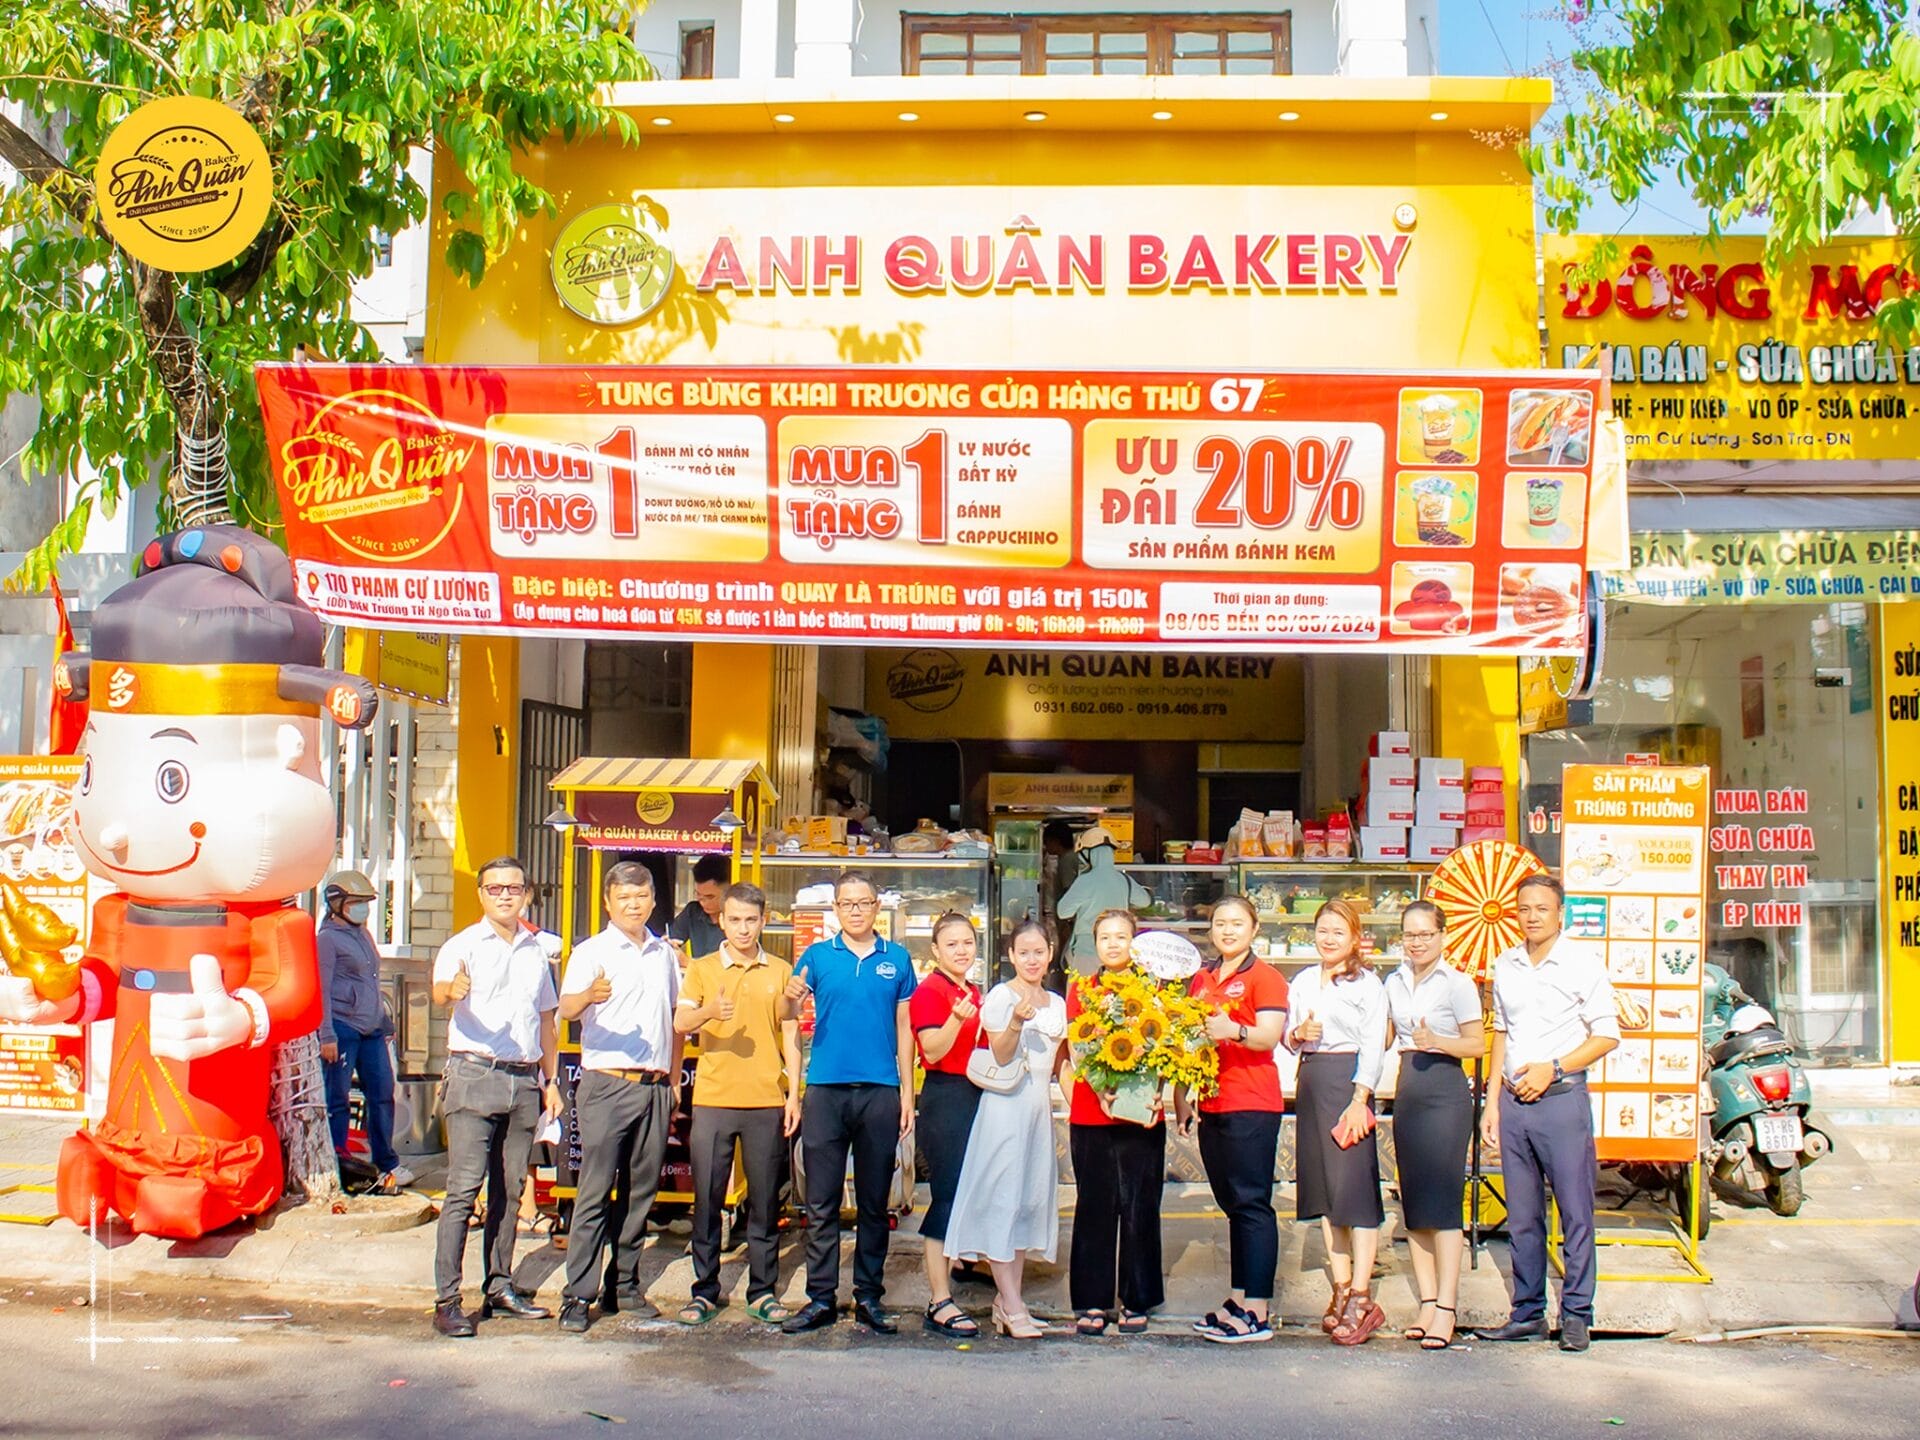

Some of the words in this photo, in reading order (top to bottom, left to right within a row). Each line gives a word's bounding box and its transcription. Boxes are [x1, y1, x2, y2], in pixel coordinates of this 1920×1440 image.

[696, 235, 861, 292] ANH
[884, 214, 1105, 293] QUÂN
[1128, 234, 1411, 292] BAKERY
[1563, 345, 1635, 382] MA
[1641, 340, 1707, 383] BÁN
[1738, 337, 1804, 384] SỬA
[1809, 341, 1898, 384] CHỮA
[683, 376, 761, 406] BỪNG
[770, 383, 837, 407] KHAI
[847, 382, 970, 409] TRƯƠNG
[980, 377, 1039, 410] CỬA
[1049, 381, 1132, 410] HÀNG
[1143, 381, 1201, 411] THỨ
[1209, 377, 1265, 412] 67
[1651, 398, 1684, 424] PHỤ
[1777, 392, 1799, 418] ỐP
[1818, 391, 1853, 419] SỬA
[1860, 394, 1907, 419] CHỮA
[406, 433, 456, 451] Bakery
[958, 442, 978, 456] LY
[983, 440, 1031, 457] NƯỚC
[1752, 431, 1783, 445] Sơn
[1826, 432, 1851, 445] ĐN
[645, 444, 676, 458] BÁNH
[679, 445, 694, 458] MÌ
[697, 445, 712, 458] CÓ
[715, 445, 750, 458] NHÂN
[281, 433, 372, 507] Anh
[371, 437, 477, 491] Quân
[715, 464, 736, 476] LÊN
[958, 461, 990, 482] BẤT
[996, 466, 1018, 482] KỲ
[492, 443, 592, 481] MUA
[595, 426, 639, 539] 1
[788, 445, 900, 487] MUA
[902, 428, 948, 546] 1
[1116, 435, 1178, 475] ƯU
[1193, 434, 1364, 530] 20%
[645, 499, 674, 508] DONUT
[957, 502, 1001, 518] BÁNH
[1100, 477, 1176, 525] ĐÃI
[494, 486, 597, 544] TẶNG
[645, 513, 668, 523] NƯỚC
[720, 514, 748, 524] CHANH
[787, 490, 901, 551] TẶNG
[356, 535, 385, 552] SINCE
[391, 537, 416, 552] 2009
[957, 530, 1059, 545] CAPPUCHINO
[1128, 536, 1170, 558] SẢN
[1173, 534, 1229, 559] PHẨM
[1234, 539, 1290, 560] BÁNH
[1294, 544, 1336, 560] KEM
[1630, 539, 1686, 568] BÁN
[325, 573, 348, 594] 170
[351, 576, 399, 601] PHẠM
[405, 576, 429, 603] CỰ
[433, 577, 490, 605] LƯỢNG
[512, 575, 556, 600] Đặc
[562, 576, 614, 602] biệt:
[619, 578, 710, 602] Chương
[715, 581, 774, 602] trình
[781, 582, 838, 603] QUAY
[845, 581, 872, 604] LÀ
[879, 582, 957, 605] TRÚNG
[963, 585, 1001, 607] với
[1008, 586, 1047, 609] giá
[1053, 587, 1083, 613] trị
[1090, 587, 1149, 609] 150k
[1213, 591, 1240, 605] Thời
[1243, 592, 1270, 606] gian
[1294, 593, 1328, 607] dụng:
[1636, 580, 1668, 600] PHỤ
[1673, 576, 1708, 600] KIỆN
[411, 605, 425, 616] TH
[453, 606, 471, 617] Gia
[513, 602, 535, 621] (Áp
[537, 604, 571, 623] dụng
[574, 605, 599, 622] cho
[602, 606, 628, 623] hoá
[630, 607, 656, 624] đơn
[659, 607, 675, 624] từ
[675, 608, 703, 625] 45K
[706, 607, 722, 626] sẽ
[725, 609, 760, 628] được
[763, 610, 771, 626] 1
[774, 608, 796, 627] lần
[799, 608, 825, 629] bốc
[828, 611, 867, 631] thăm,
[870, 613, 908, 632] trong
[911, 613, 953, 634] khung
[984, 615, 1003, 632] 8h
[1016, 616, 1039, 635] 9h;
[1041, 616, 1085, 633] 16h30
[1165, 613, 1219, 631] 08/05
[984, 653, 1051, 677] ANH
[1162, 656, 1275, 679] BAKERY
[1062, 682, 1099, 698] lượng
[1034, 702, 1124, 715] 0931.602.060
[1137, 703, 1227, 716] 0919.406.879
[1025, 783, 1049, 793] ANH
[1593, 772, 1626, 792] SẢN
[1629, 770, 1676, 793] PHẨM
[1575, 797, 1627, 817] TRÚNG
[1630, 797, 1695, 818] THƯỞNG
[1715, 789, 1761, 814] MUA
[1765, 786, 1808, 814] BÁN
[577, 826, 601, 839] ANH
[604, 825, 636, 840] QUÂN
[638, 828, 679, 841] BAKERY
[681, 830, 690, 842] &
[693, 830, 732, 843] COFFEE
[1640, 853, 1692, 864] 150.000
[1714, 864, 1769, 890] THAY
[1771, 864, 1808, 889] PIN
[1723, 899, 1749, 927] ÉP
[1752, 899, 1802, 927] KÍNH
